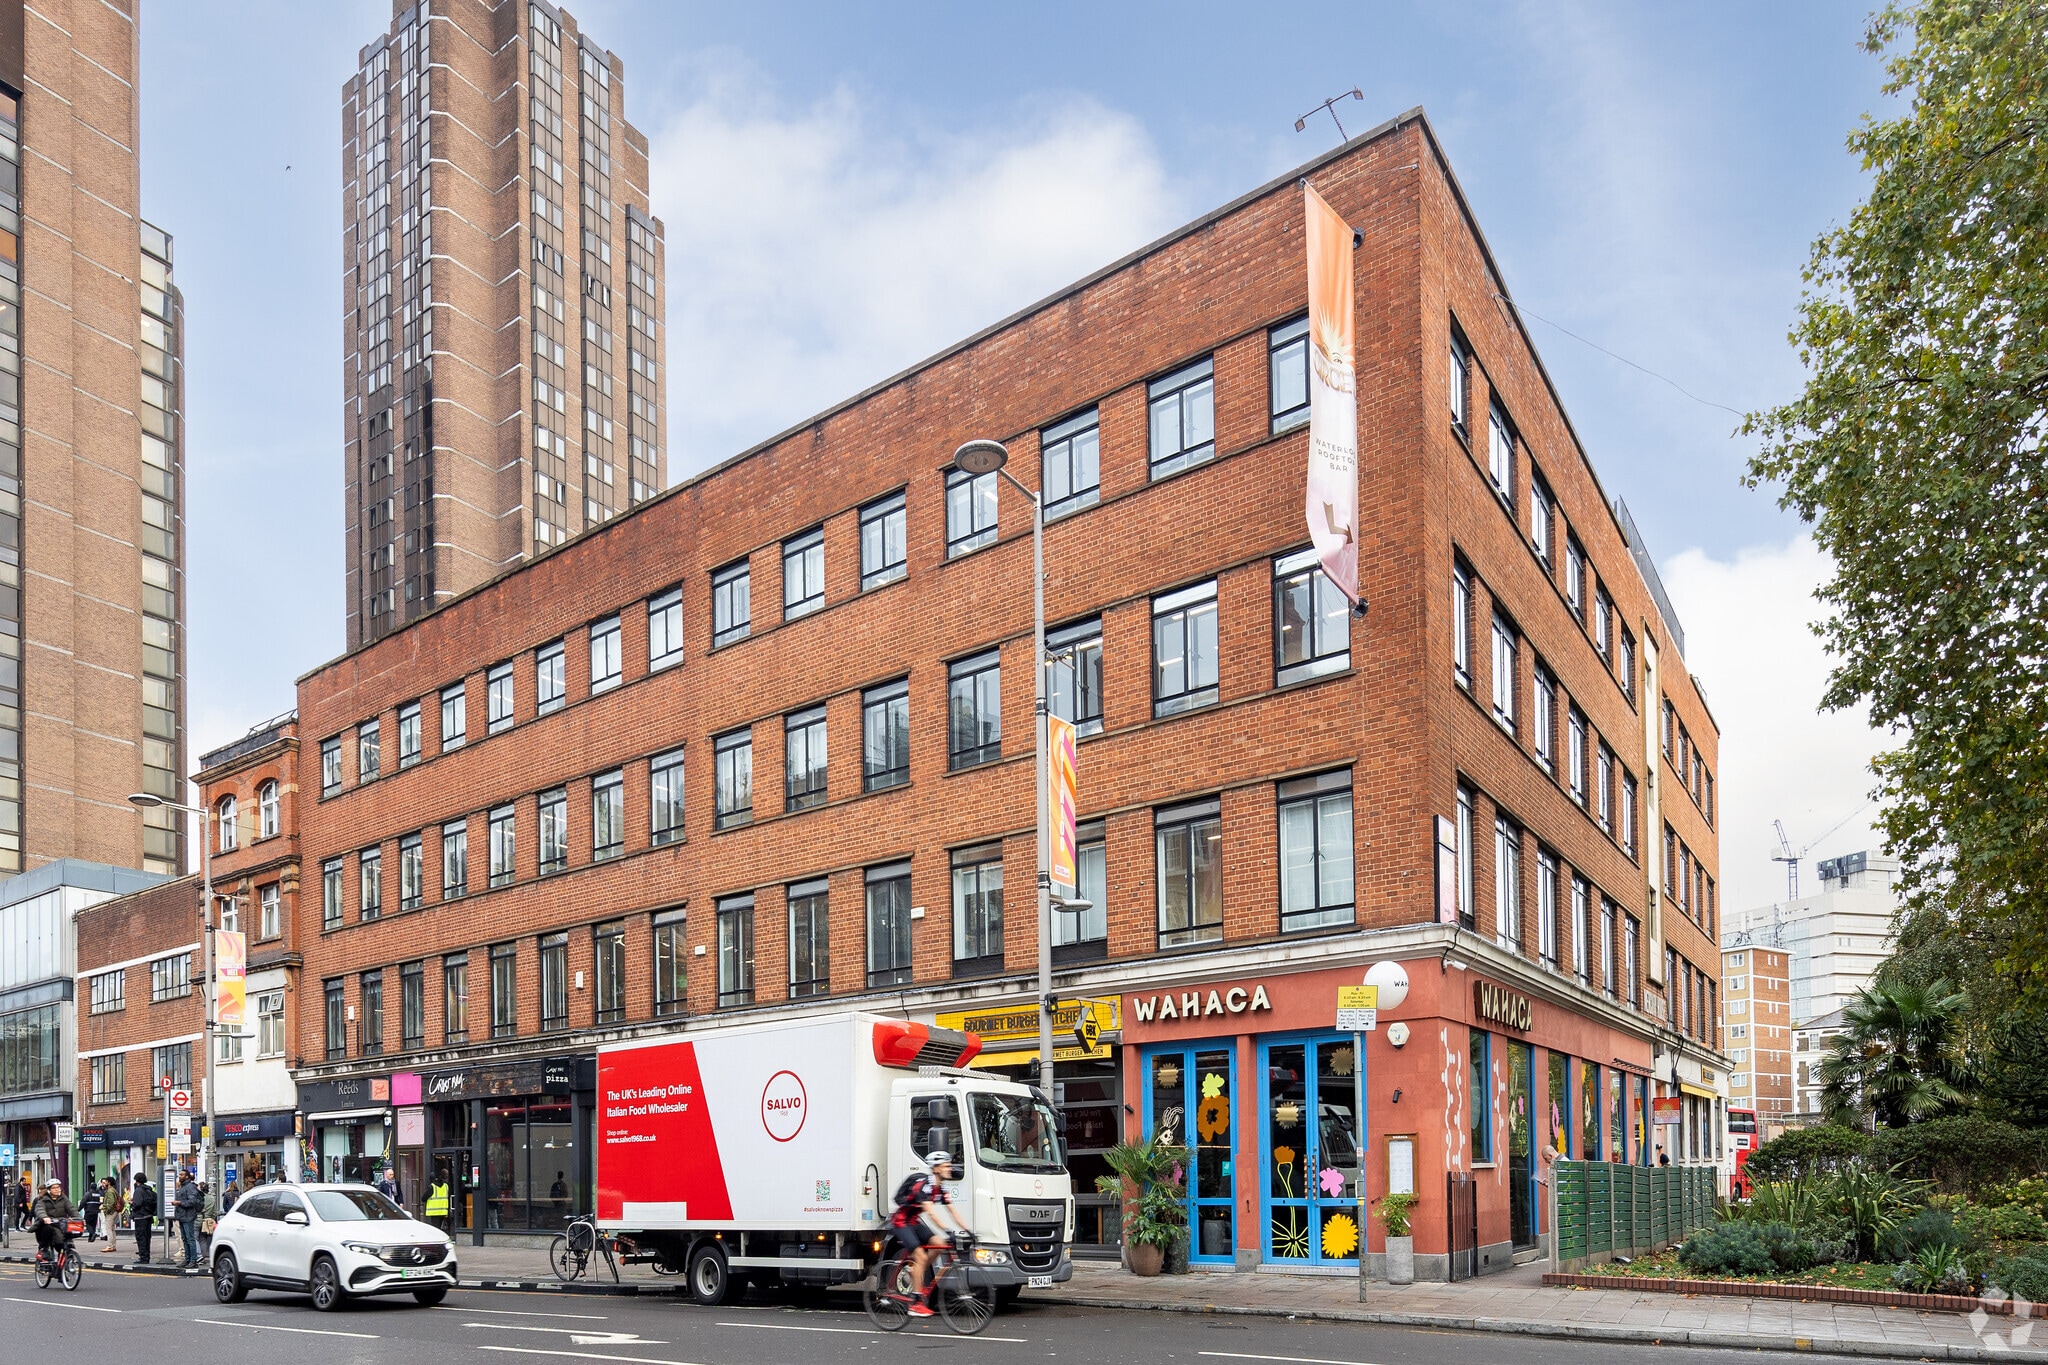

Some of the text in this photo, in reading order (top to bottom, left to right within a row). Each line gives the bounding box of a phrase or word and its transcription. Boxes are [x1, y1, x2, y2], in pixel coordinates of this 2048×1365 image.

[1330, 462, 1348, 472] BAR
[1133, 984, 1271, 1021] WAHACA
[1480, 980, 1533, 1031] WAHACA
[964, 1009, 1080, 1032] GOURMET BURGE ITCHE
[1085, 1023, 1097, 1036] GBK
[163, 1078, 171, 1088] D
[545, 1074, 569, 1084] pizza
[338, 1081, 359, 1095] Reeds
[607, 1084, 692, 1101] The UK's Leading Online
[607, 1102, 688, 1117] Italian Food Wholesaler
[767, 1097, 801, 1110] SALVO
[225, 1124, 259, 1133] TESCO express
[607, 1134, 657, 1144] www.salvo1968.co.uk
[1029, 1210, 1051, 1218] DAF
